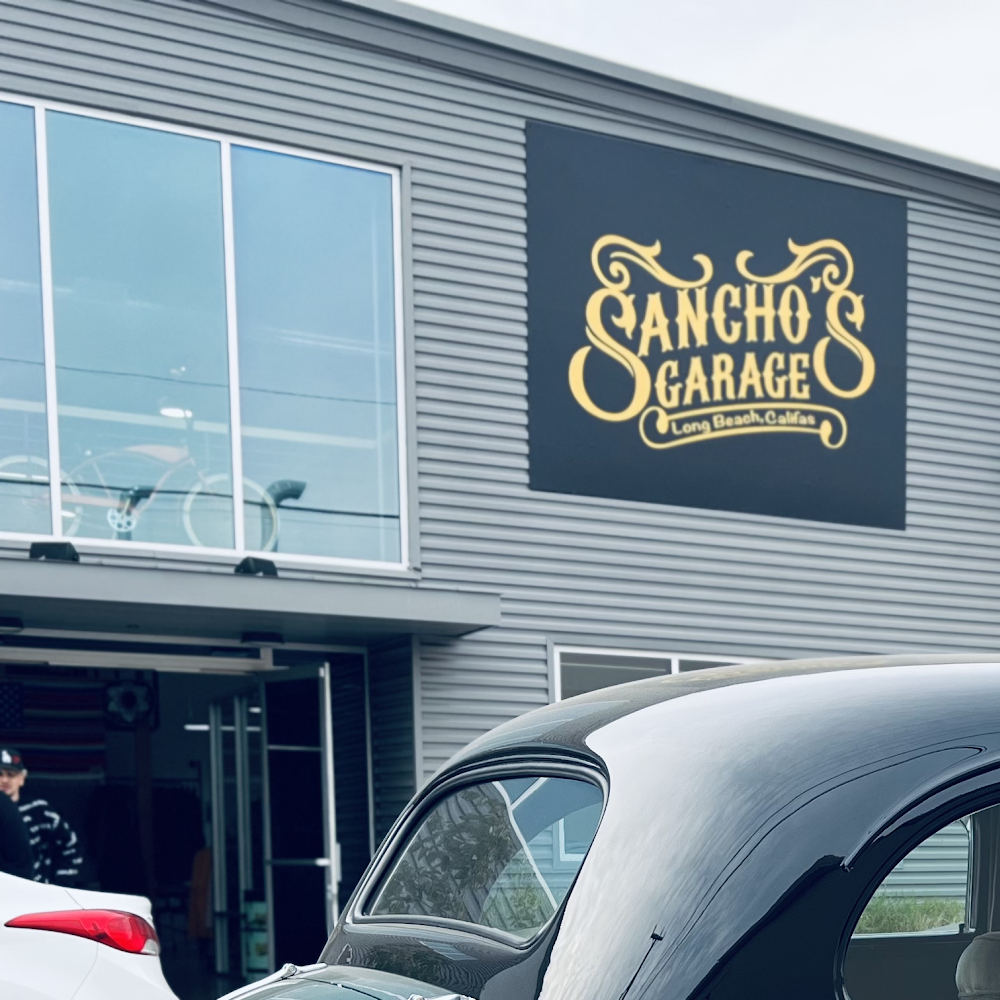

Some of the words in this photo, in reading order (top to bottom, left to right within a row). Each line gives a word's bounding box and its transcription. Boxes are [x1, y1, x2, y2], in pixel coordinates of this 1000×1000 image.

[569, 275, 875, 422] SANCHO'S
[655, 352, 810, 409] GARAGE
[671, 420, 711, 435] Long
[765, 410, 816, 425] Califas
